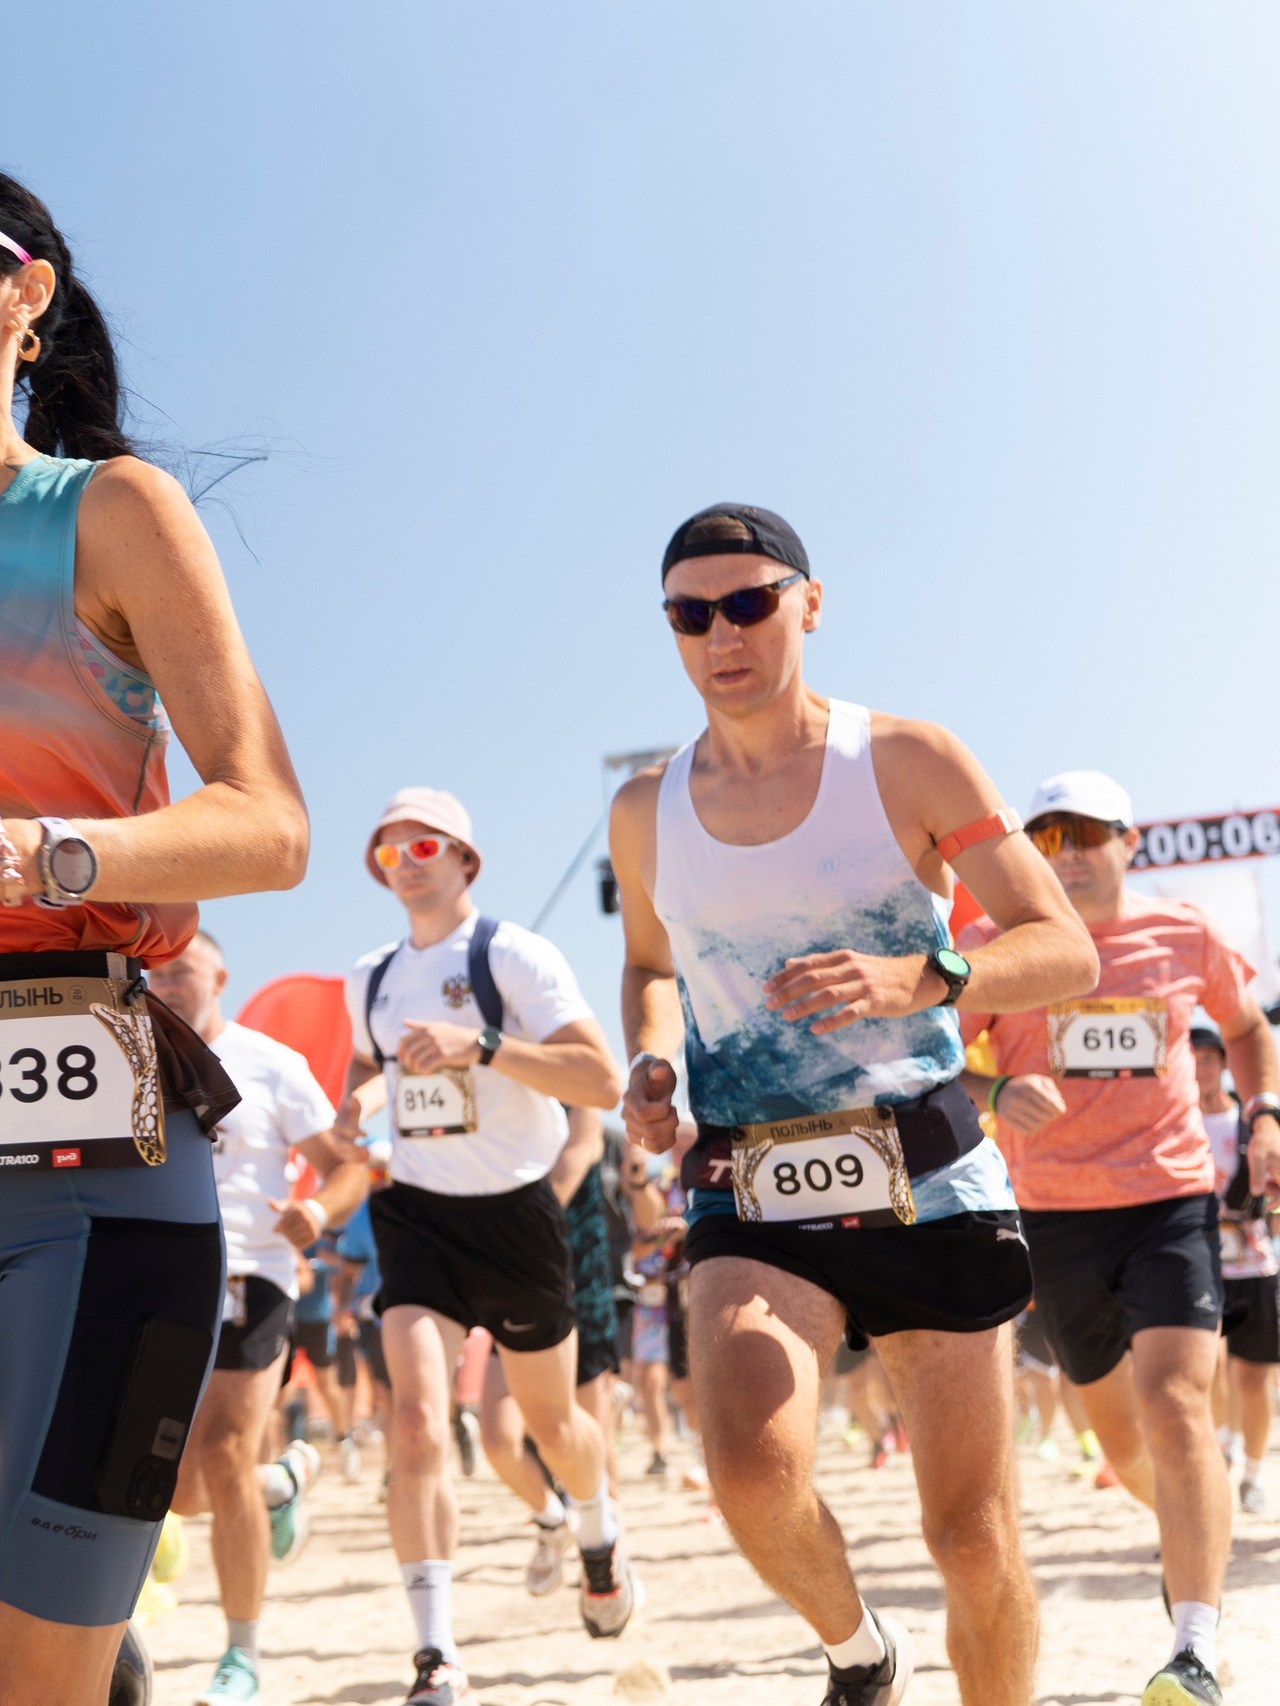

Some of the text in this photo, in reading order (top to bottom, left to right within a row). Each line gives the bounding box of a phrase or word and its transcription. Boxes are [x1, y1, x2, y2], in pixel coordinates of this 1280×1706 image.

[1082, 1027, 1137, 1051] 616
[403, 1086, 446, 1112] 814
[769, 1118, 833, 1141] ПОЛЫНЬ
[773, 1153, 865, 1196] 809
